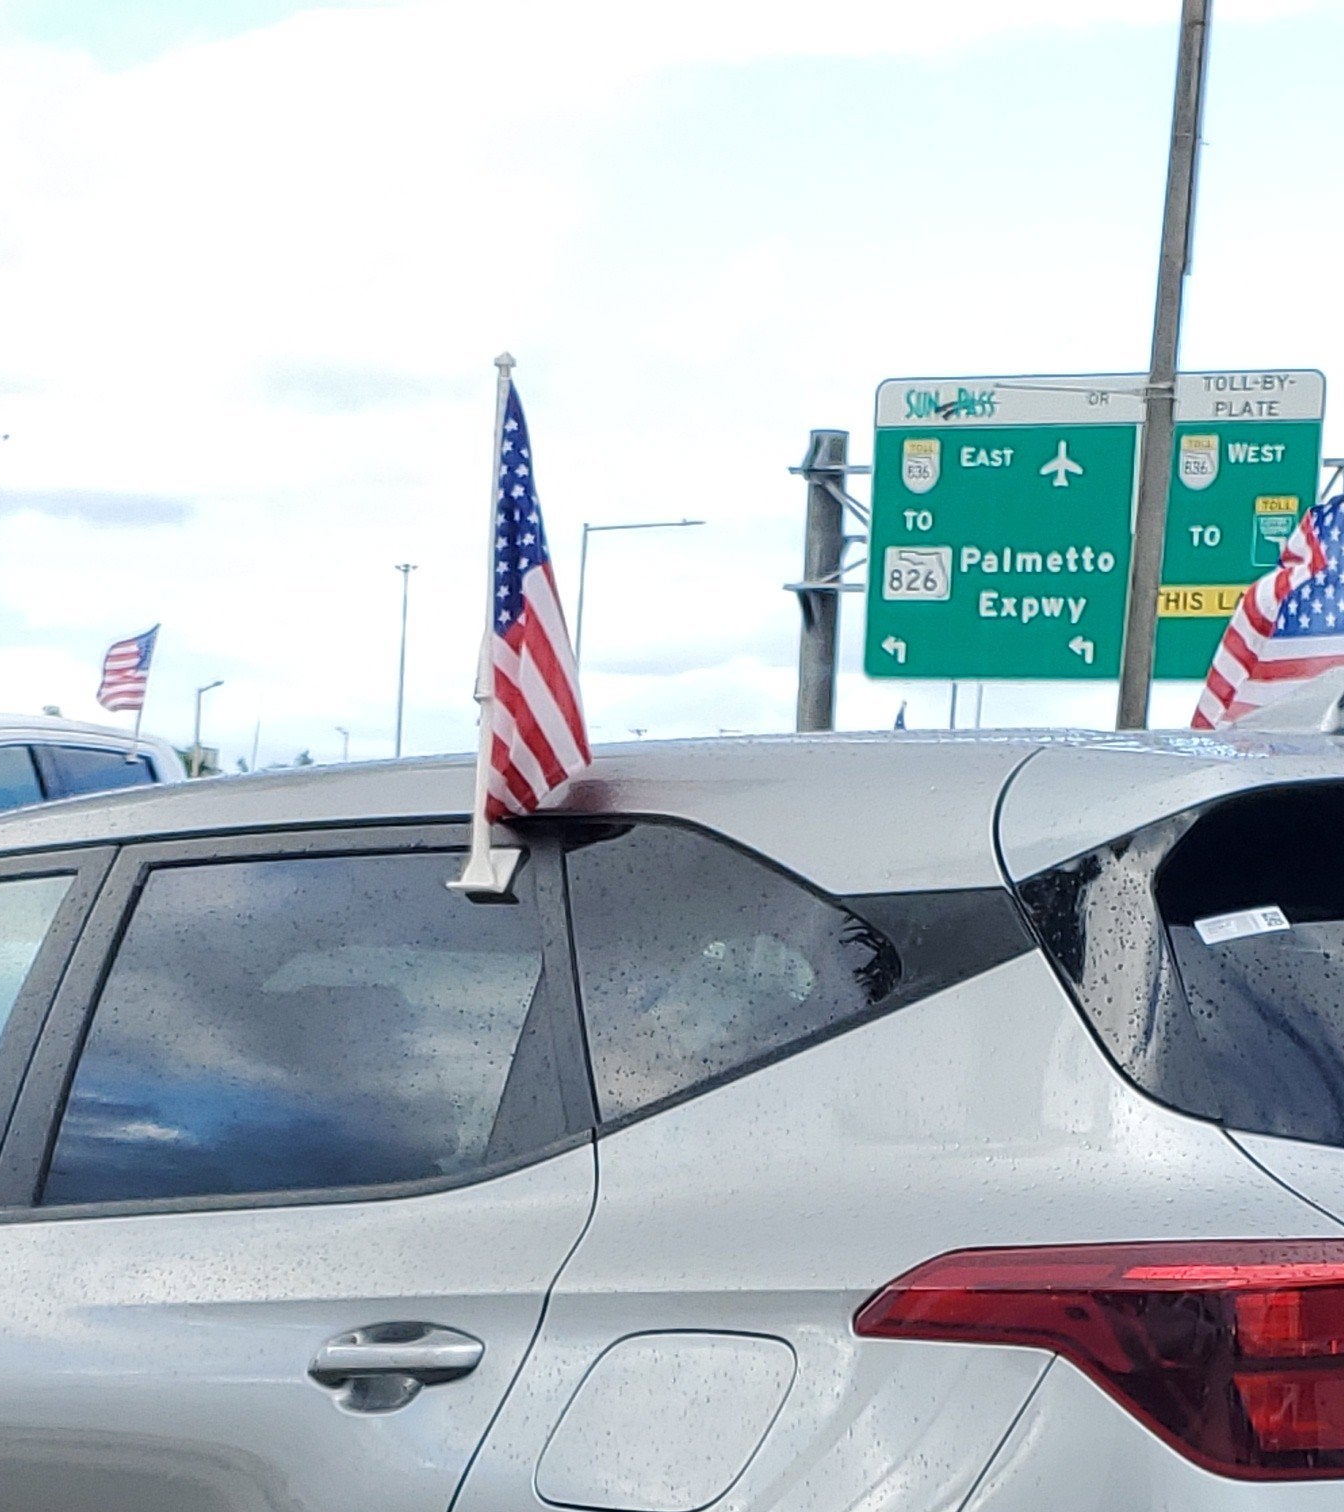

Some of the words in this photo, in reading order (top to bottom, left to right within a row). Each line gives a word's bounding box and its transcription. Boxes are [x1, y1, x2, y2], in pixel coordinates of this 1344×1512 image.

[1202, 374, 1297, 392] TOLL-BY-
[1088, 391, 1110, 406] OR
[1214, 400, 1282, 418] PLATE
[960, 447, 1015, 467] EAST
[1227, 443, 1286, 463] WEST
[1261, 499, 1293, 511] TOLL
[903, 509, 933, 531] TO
[1188, 525, 1221, 547] TO
[959, 546, 1116, 573] Palmetto
[889, 568, 938, 592] 826
[978, 589, 1087, 624] Expwy
[1217, 591, 1245, 611] L
